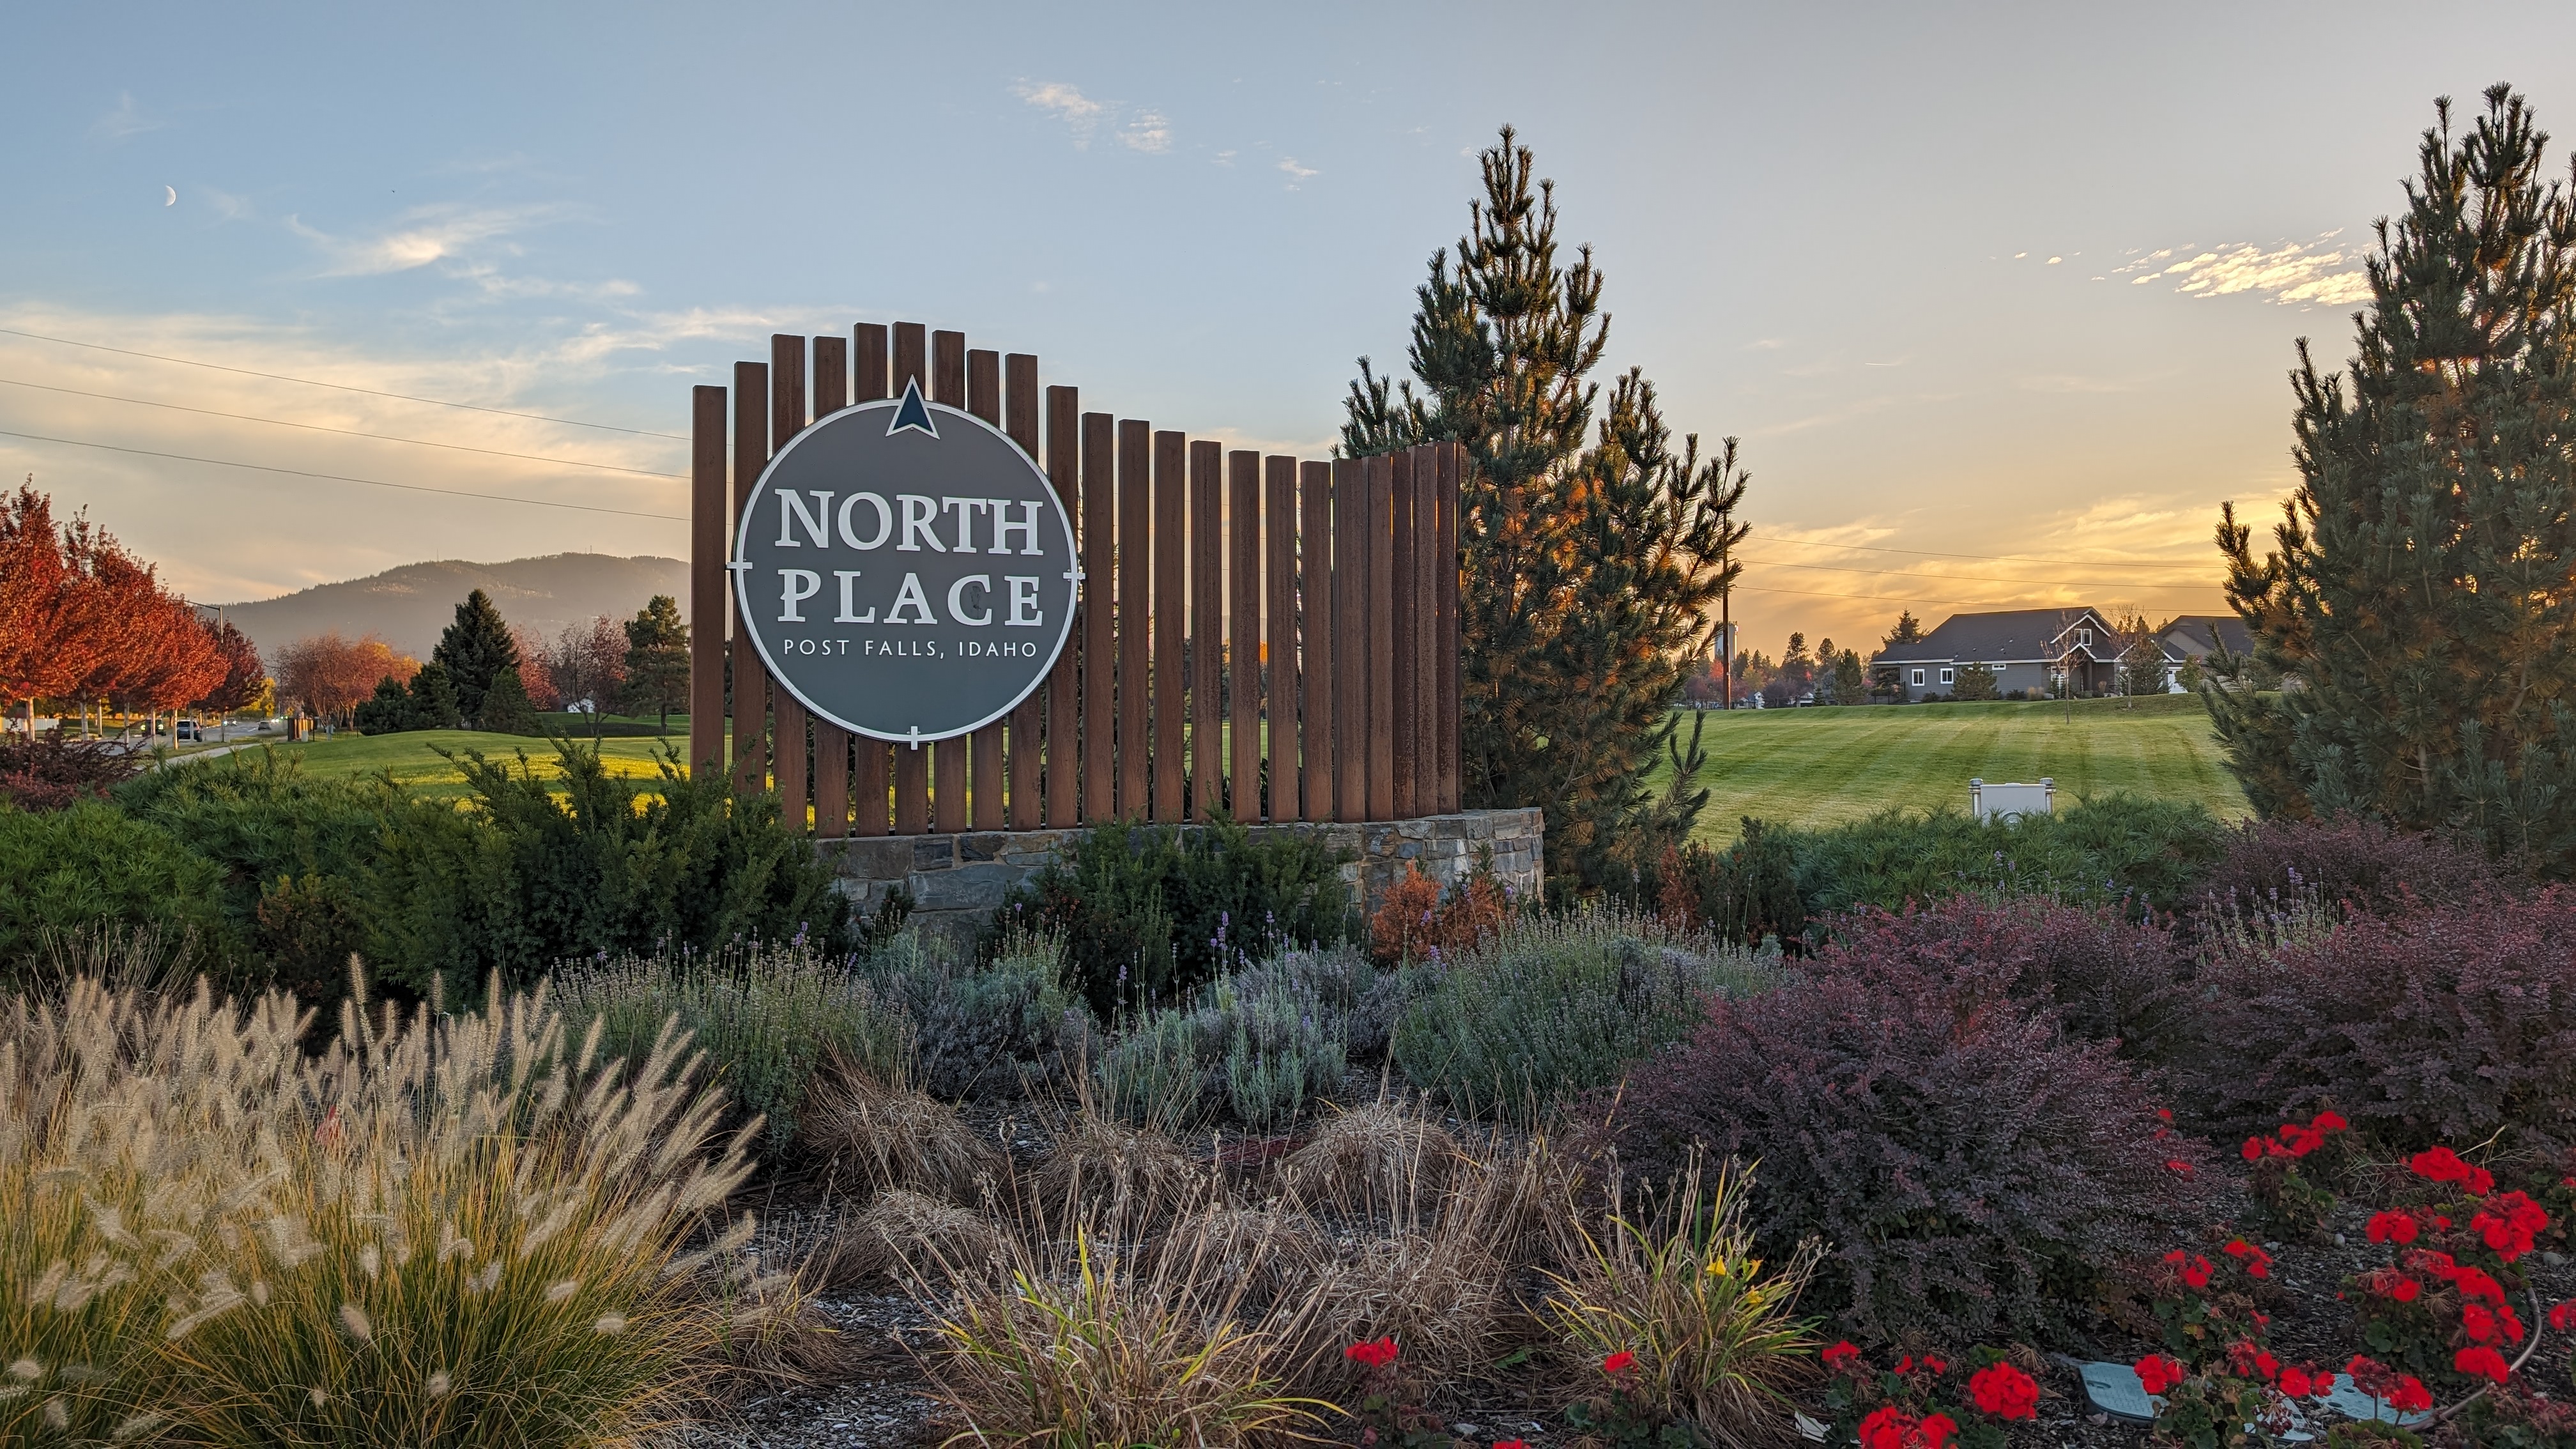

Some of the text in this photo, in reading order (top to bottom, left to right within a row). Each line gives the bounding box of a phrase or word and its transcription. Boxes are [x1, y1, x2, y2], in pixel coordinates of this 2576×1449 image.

[774, 488, 1044, 556] NORTH
[777, 569, 1043, 627] PLACE
[784, 639, 1036, 659] POST FALLS, IDAHO
